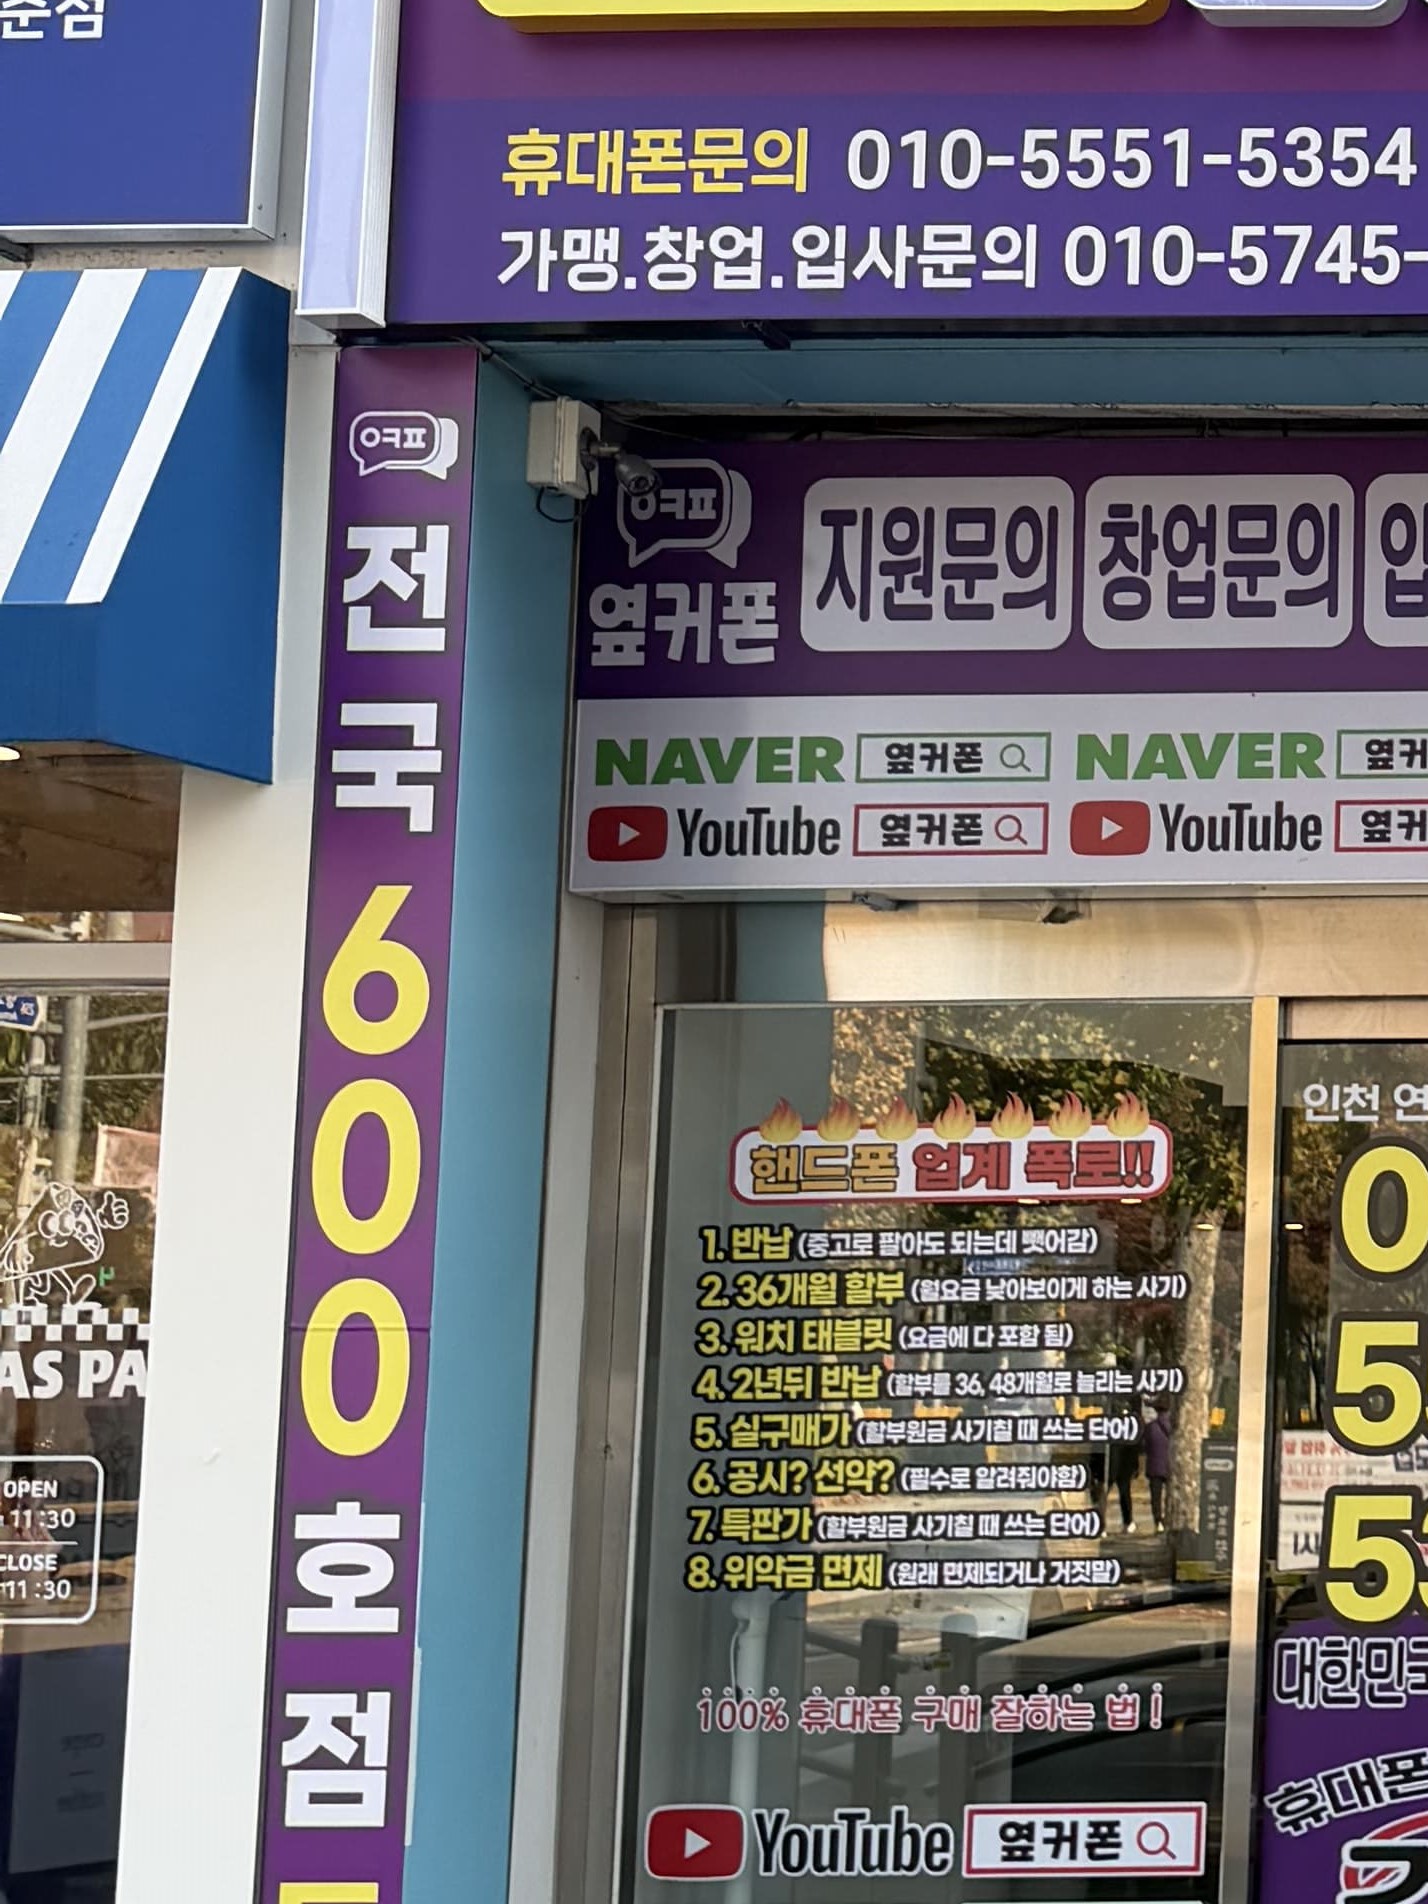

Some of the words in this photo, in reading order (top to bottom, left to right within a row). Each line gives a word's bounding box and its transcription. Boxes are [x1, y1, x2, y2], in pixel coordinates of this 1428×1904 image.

[500, 129, 809, 194] 휴대폰문의
[846, 127, 1417, 190] 010-5551-5354
[816, 505, 1058, 623] 지원문의
[1099, 501, 1340, 621] 창업문의
[590, 582, 780, 666] 옆커폰
[597, 736, 843, 784] NAVER
[885, 743, 983, 775] 옆커폰
[1076, 733, 1324, 780] NAVER
[679, 807, 840, 855] YouTube
[880, 813, 983, 847] 옆커폰
[1160, 803, 1322, 852] YouTube
[1303, 1084, 1380, 1122] 인천
[750, 1145, 899, 1194] 핸드폰
[912, 1143, 1011, 1190] 업계
[1025, 1140, 1153, 1187] 폭로!!
[731, 1226, 793, 1260] 반납
[736, 1272, 837, 1306] 36개월
[845, 1272, 904, 1305] 할부
[735, 1320, 794, 1353] 워치
[802, 1318, 892, 1352] 태블릿
[731, 1366, 812, 1400] 2년뒤
[822, 1366, 881, 1399] 반납
[730, 1414, 852, 1448] 실구매가
[4, 1480, 58, 1498] OPEN
[728, 1460, 808, 1494] 공시?
[815, 1459, 895, 1493] 선약?
[721, 1508, 813, 1541] 특판가
[724, 1555, 815, 1588] 위약금
[822, 1553, 882, 1587] 면제
[697, 1697, 787, 1733] 100%
[799, 1694, 901, 1733] 휴대폰
[914, 1693, 981, 1731] 구매
[993, 1691, 1094, 1731] 잘하는
[1105, 1691, 1140, 1730] 법
[755, 1809, 952, 1874] YouTube
[999, 1821, 1122, 1863] 옆커폰
